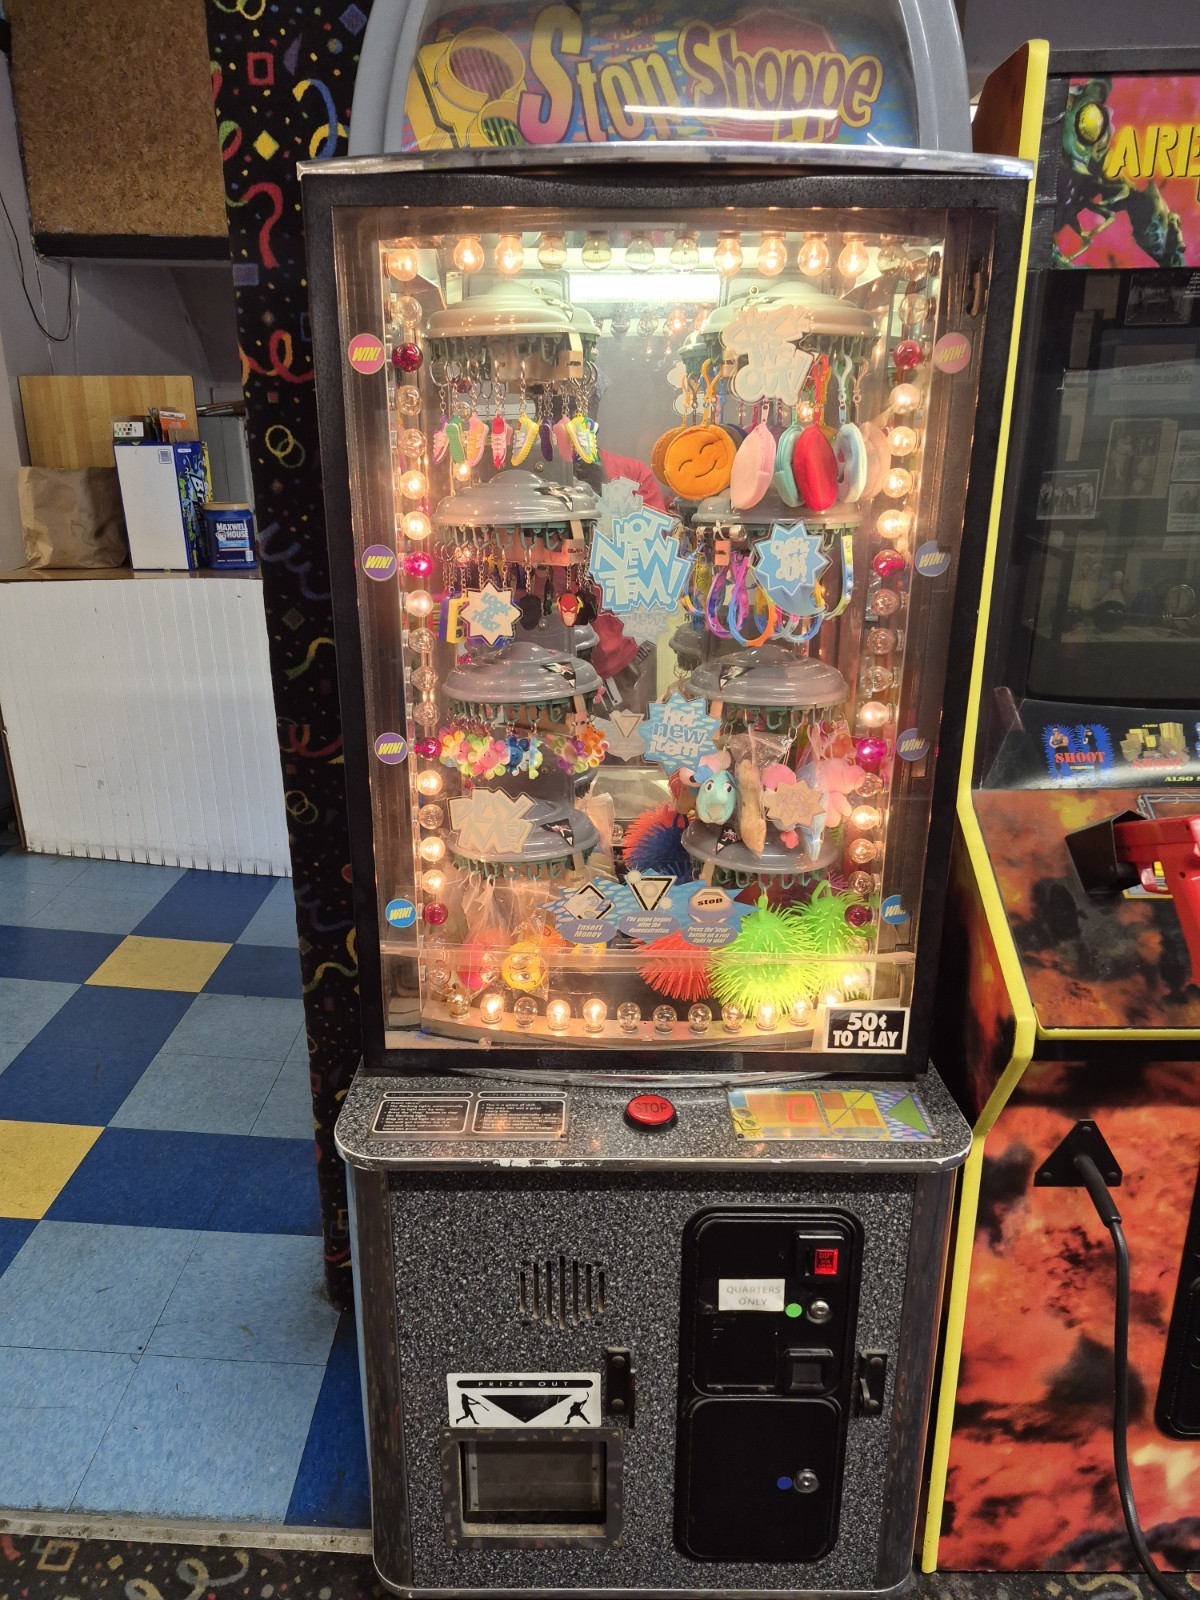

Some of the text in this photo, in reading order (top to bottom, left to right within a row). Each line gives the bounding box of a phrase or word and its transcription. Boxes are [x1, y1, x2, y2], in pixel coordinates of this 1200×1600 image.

[678, 19, 883, 144] Shoppe
[352, 346, 382, 361] WIN!
[941, 343, 967, 362] WIN!
[216, 522, 248, 531] MAXWELL
[616, 509, 669, 547] HOT
[227, 531, 249, 539] HOUSE
[594, 536, 673, 570] NEW
[918, 551, 946, 568] WIN!
[365, 555, 393, 569] WIN!
[652, 722, 706, 745] new
[378, 742, 404, 755] WIN!
[900, 738, 925, 753] WIN!
[1055, 752, 1105, 763] SHOOT
[697, 898, 723, 906] stop
[847, 1012, 888, 1031] 50¢
[833, 1030, 899, 1047] TO PLAY
[634, 1102, 668, 1114] STOP
[726, 1286, 782, 1295] QUARTERS
[738, 1297, 768, 1306] ONLY
